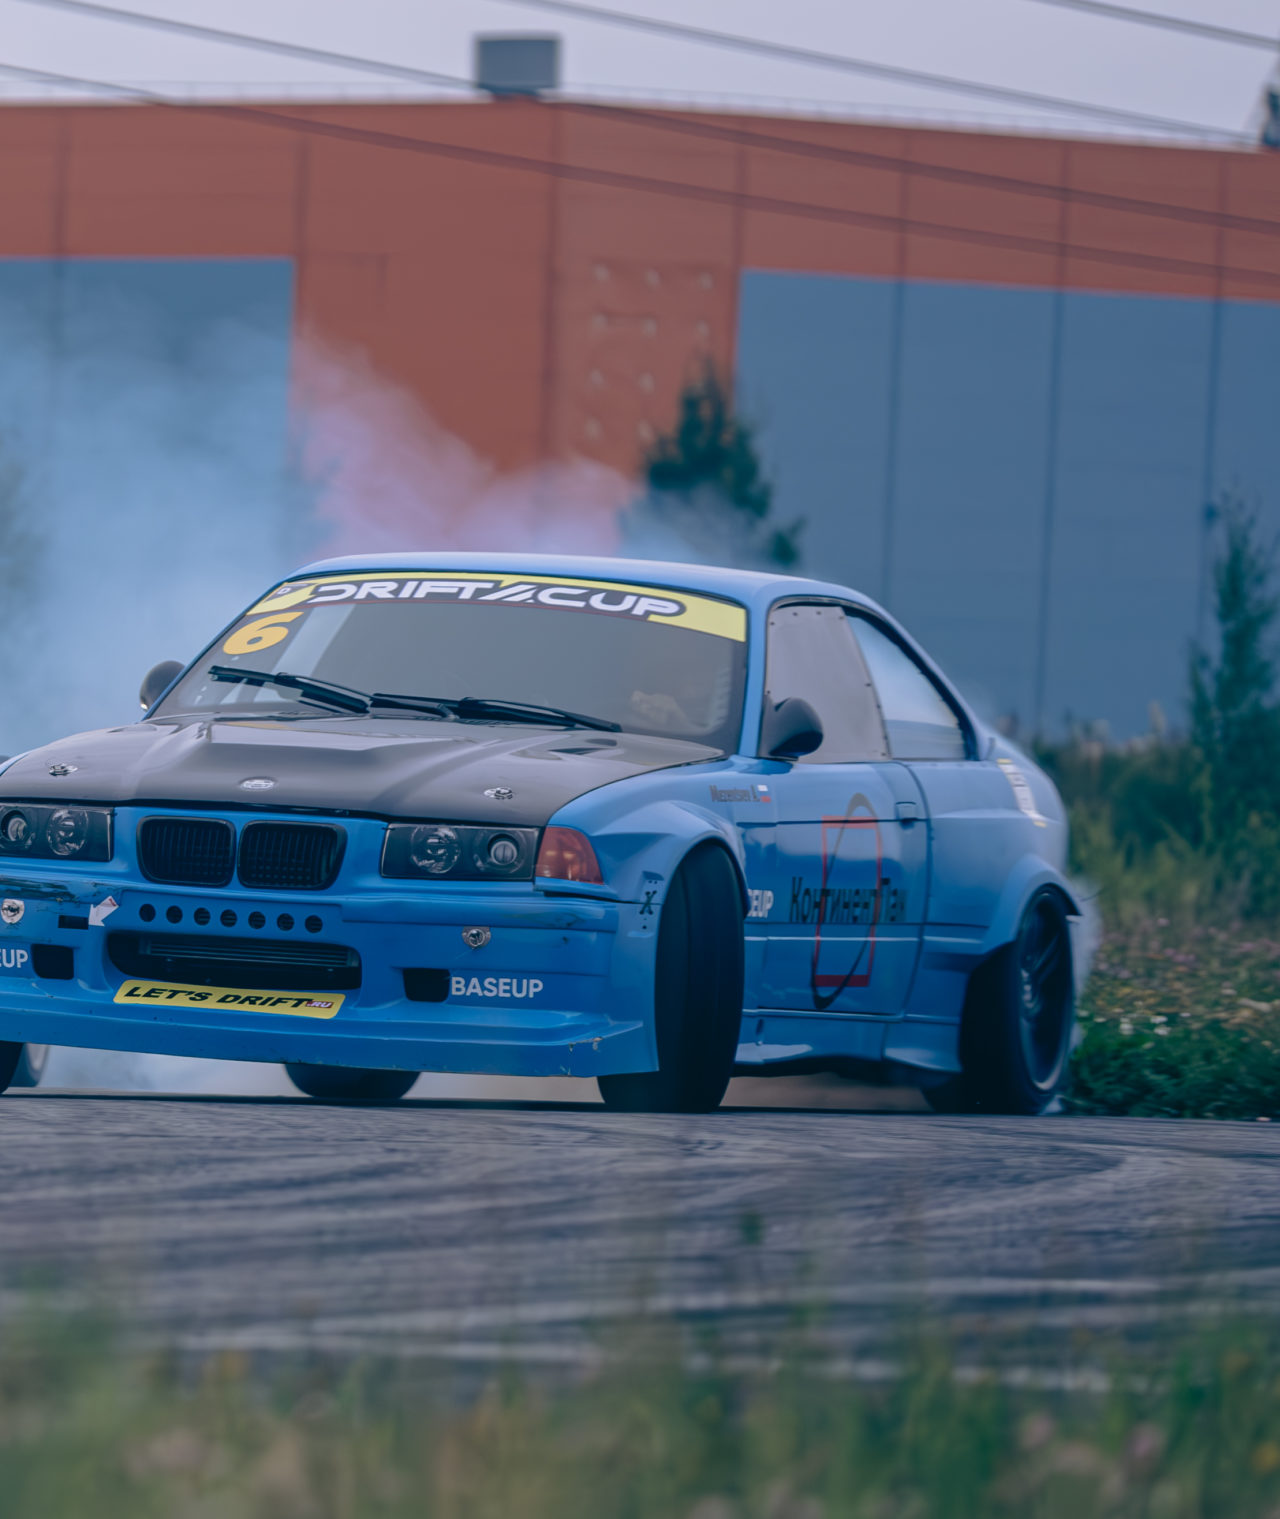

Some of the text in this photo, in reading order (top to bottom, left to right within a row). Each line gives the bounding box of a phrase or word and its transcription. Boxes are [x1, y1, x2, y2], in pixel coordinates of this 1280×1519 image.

[223, 611, 305, 655] 6
[124, 986, 213, 1002] LET'S
[451, 976, 544, 998] BASEUP
